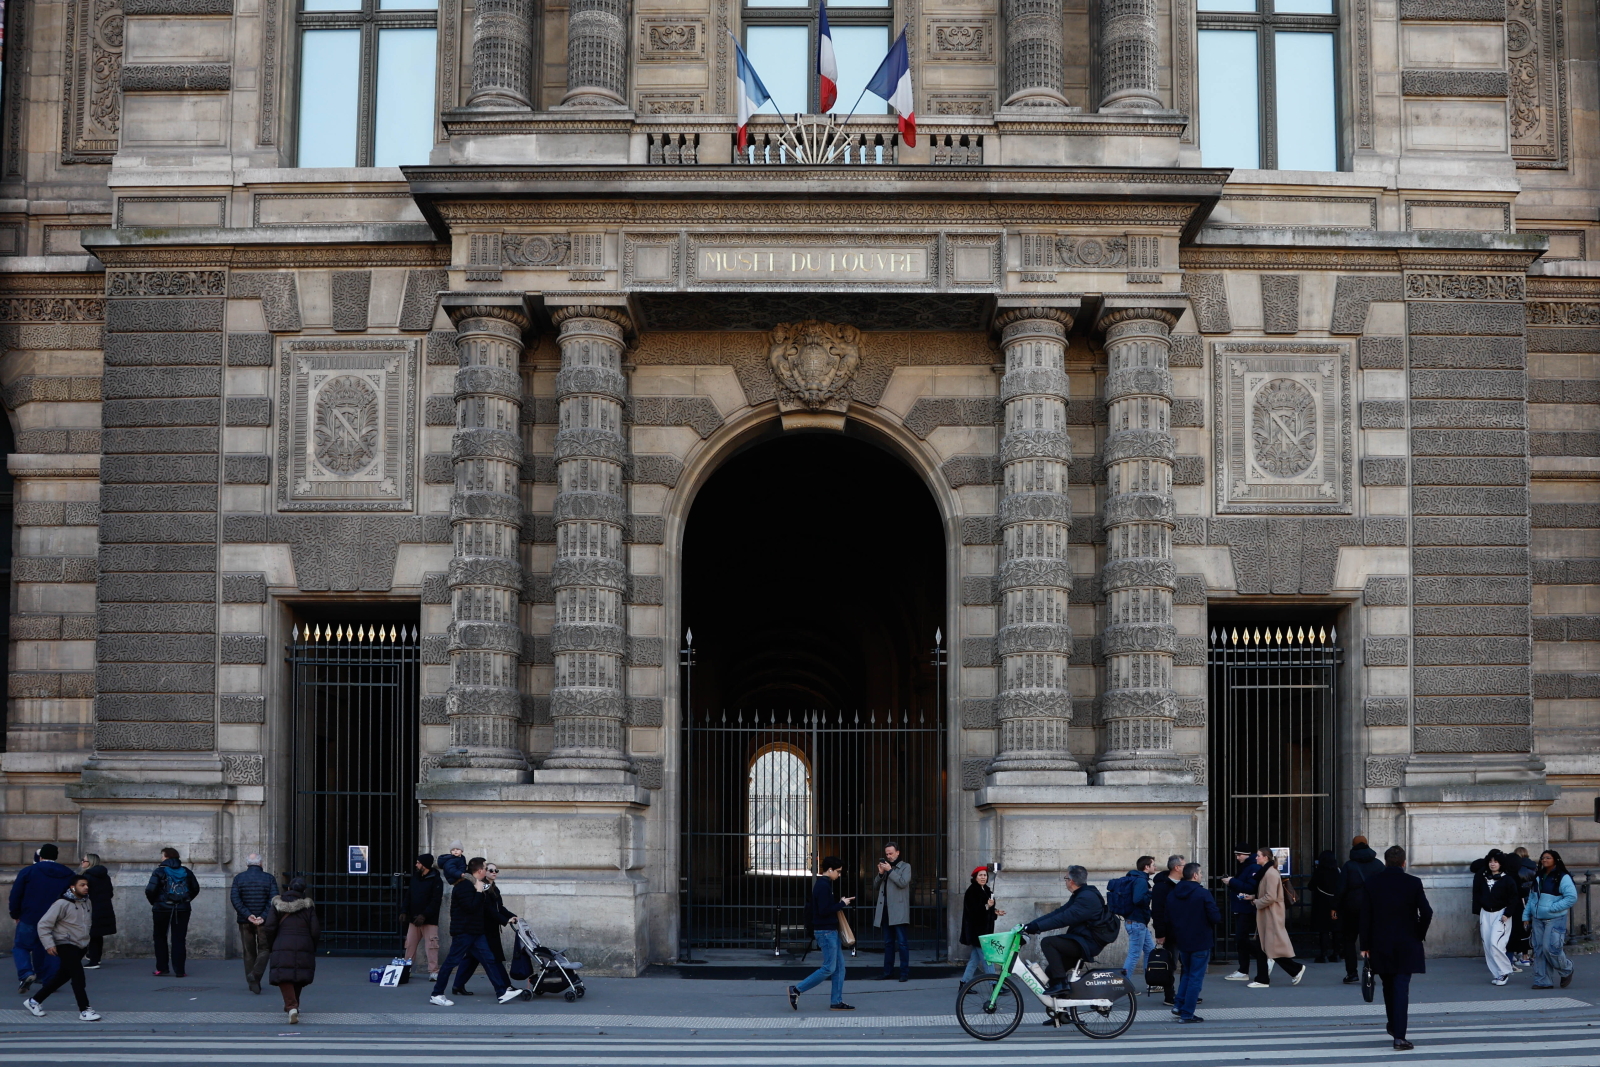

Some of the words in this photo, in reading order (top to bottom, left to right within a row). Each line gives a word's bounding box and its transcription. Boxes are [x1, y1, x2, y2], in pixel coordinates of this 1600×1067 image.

[705, 251, 784, 272] MUSEE
[791, 251, 822, 272] DU
[830, 251, 921, 272] LOUVRE
[1021, 971, 1043, 995] Lime
